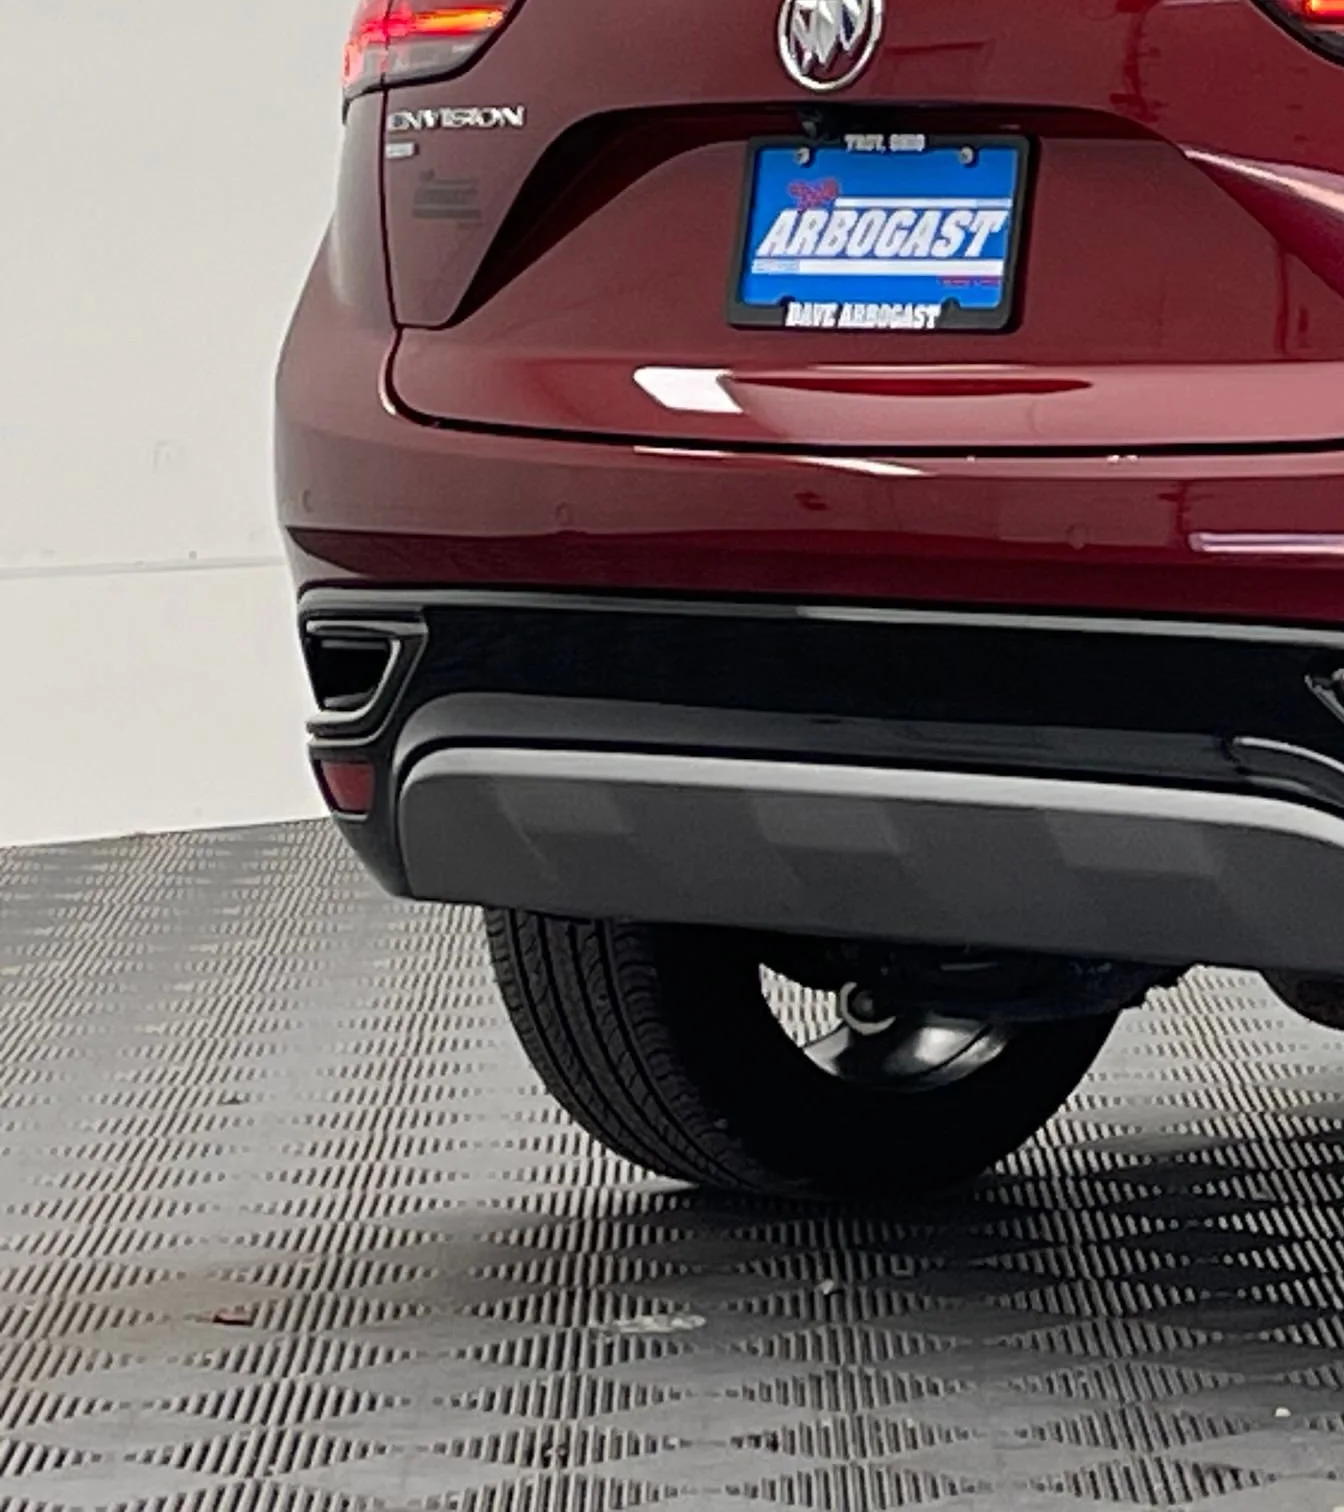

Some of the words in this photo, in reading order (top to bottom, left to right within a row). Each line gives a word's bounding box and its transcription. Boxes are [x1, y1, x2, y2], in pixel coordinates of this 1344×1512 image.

[387, 105, 526, 130] ENVISION
[755, 209, 1009, 258] ARBOGAST
[785, 301, 838, 328] DAVE
[838, 302, 942, 330] ARBOGAST
